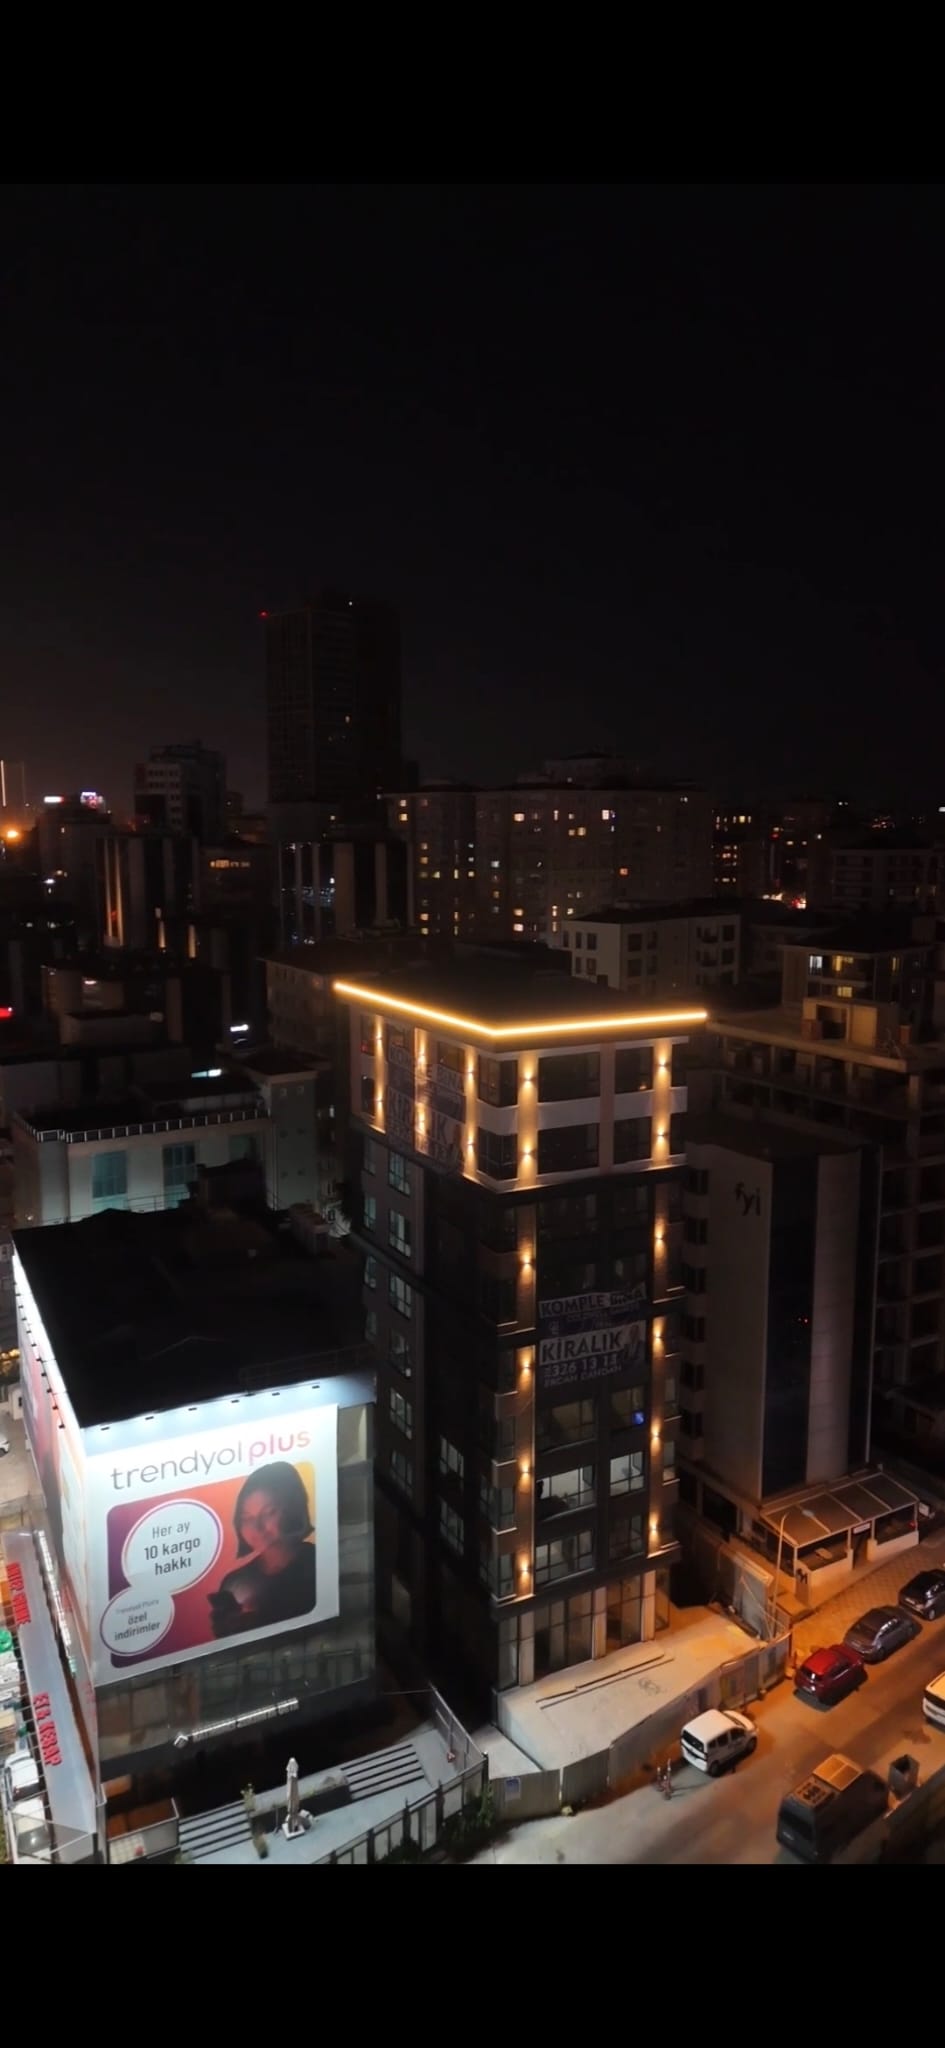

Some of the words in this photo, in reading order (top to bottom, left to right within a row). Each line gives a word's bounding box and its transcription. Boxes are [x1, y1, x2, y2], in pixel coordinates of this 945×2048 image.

[735, 1181, 761, 1217] fyi
[540, 1294, 605, 1317] KOMPLE
[541, 1331, 623, 1363] KİRALIK
[110, 1439, 243, 1491] trendyol
[248, 1430, 311, 1467] plus
[152, 1524, 173, 1540] Her
[176, 1521, 191, 1535] ay
[143, 1545, 158, 1561] 10
[161, 1537, 201, 1557] kargo
[154, 1556, 192, 1576] hakkı
[127, 1611, 148, 1626] özel
[114, 1621, 161, 1641] indirimler
